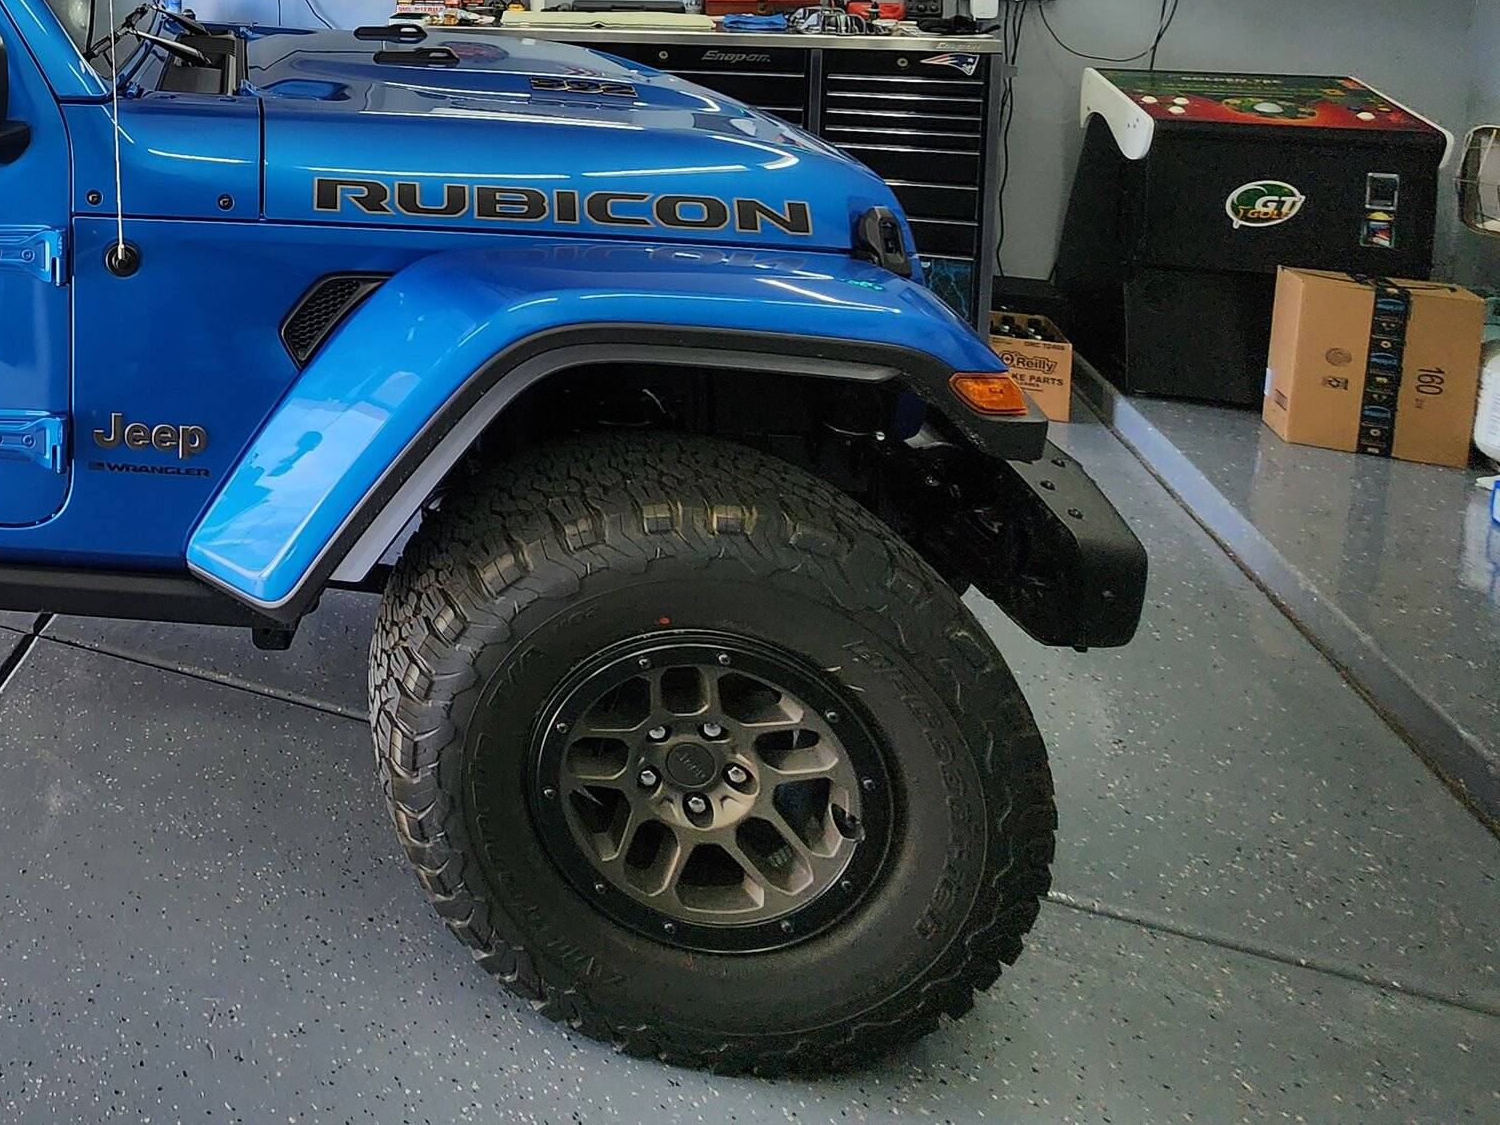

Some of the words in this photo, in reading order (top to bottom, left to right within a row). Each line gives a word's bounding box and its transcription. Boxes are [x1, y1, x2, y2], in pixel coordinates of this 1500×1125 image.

[313, 177, 814, 236] RUBICON
[1255, 195, 1301, 214] GT
[1029, 374, 1064, 387] PARTS
[1415, 366, 1446, 396] 160
[93, 412, 208, 460] Jeep
[105, 460, 211, 478] WRANGLER
